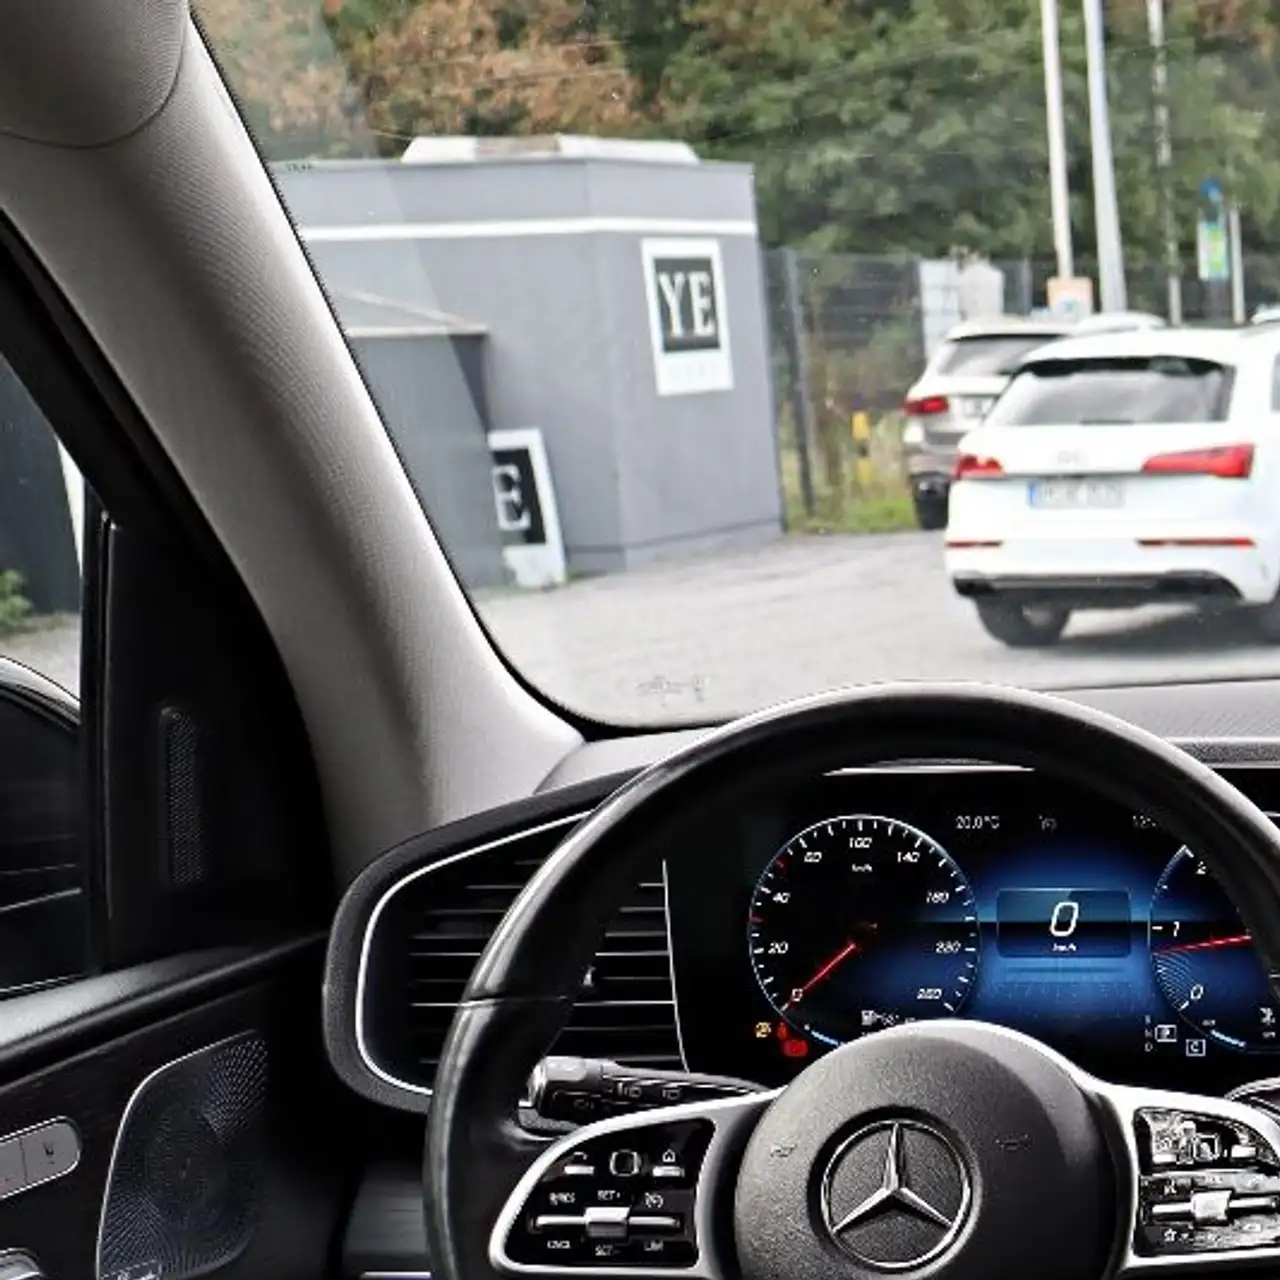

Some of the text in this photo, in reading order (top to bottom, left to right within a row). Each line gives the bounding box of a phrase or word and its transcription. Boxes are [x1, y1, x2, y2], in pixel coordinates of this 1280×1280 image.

[658, 271, 716, 337] YE
[849, 837, 873, 849] 100
[898, 851, 921, 863] 140
[1195, 861, 1206, 875] 2
[1049, 901, 1079, 937] 0
[1172, 921, 1181, 937] 1
[768, 940, 789, 955] 20
[1190, 983, 1204, 1000] 0
